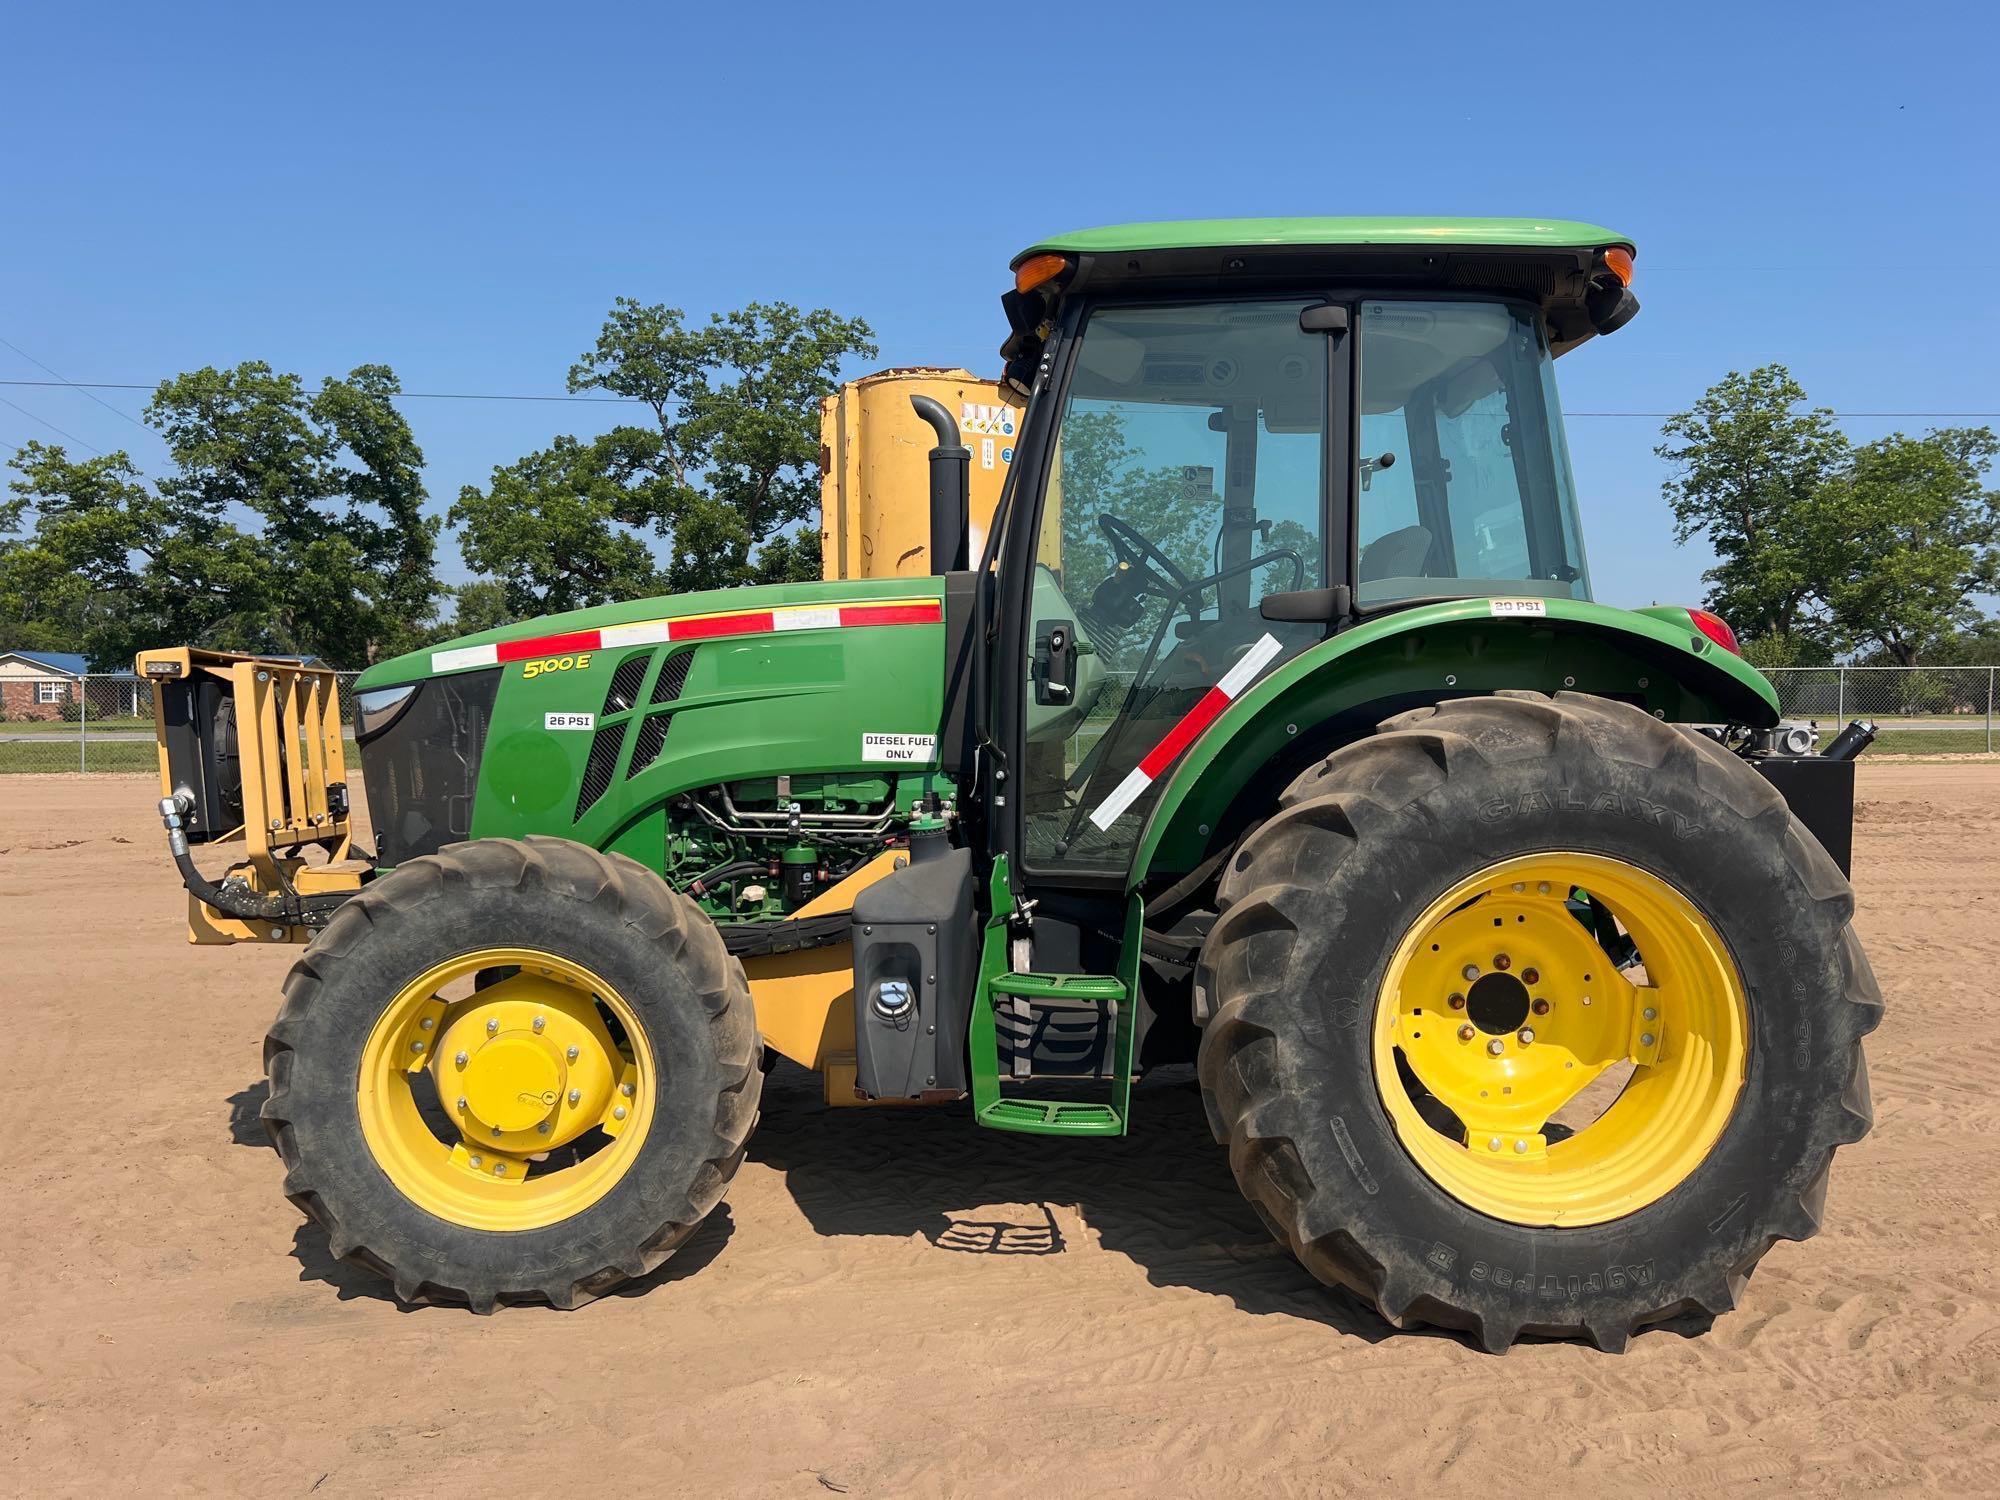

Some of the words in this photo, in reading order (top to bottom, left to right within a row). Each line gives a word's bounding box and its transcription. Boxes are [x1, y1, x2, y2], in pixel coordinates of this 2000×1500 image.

[1494, 601, 1513, 611] 20
[1516, 602, 1541, 611] PSI
[522, 657, 575, 679] 5100
[575, 654, 592, 670] E
[549, 716, 566, 726] 26
[568, 717, 590, 726] PSI
[865, 736, 906, 746] DIESEL
[908, 737, 935, 746] FUEL
[885, 750, 914, 759] ONLY
[1477, 788, 1706, 842] GALAXY
[1470, 1258, 1656, 1304] AgriTrac
